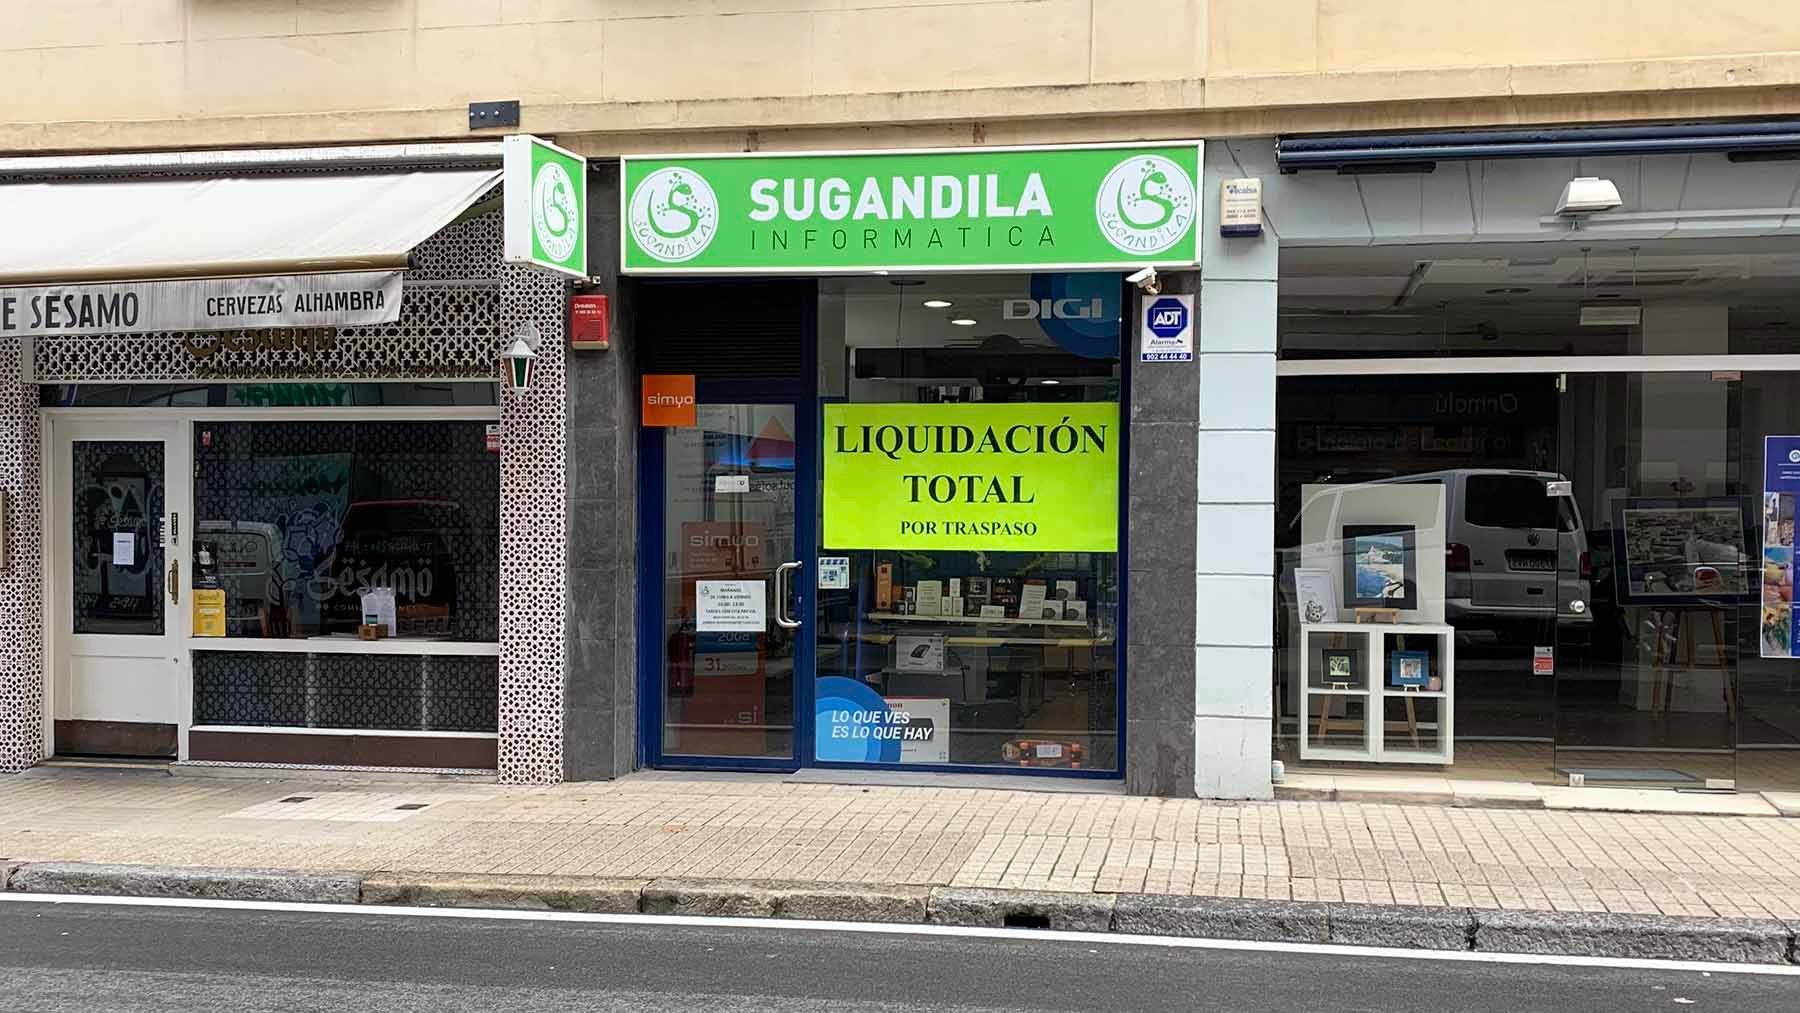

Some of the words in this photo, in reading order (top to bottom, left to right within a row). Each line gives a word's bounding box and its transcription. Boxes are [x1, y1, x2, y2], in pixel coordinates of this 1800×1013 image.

[747, 172, 1054, 222] SUGANDILA
[751, 225, 1055, 250] INFORMATICA
[30, 292, 139, 329] SESAMO
[206, 294, 283, 317] CERVEZAS
[294, 290, 385, 313] ALHAMBRA
[1003, 298, 1103, 320] DIGI
[1153, 312, 1182, 326] ADT
[647, 392, 694, 408] simyo
[834, 416, 1108, 460] LIQUIDACIÓN
[903, 475, 1035, 503] TOTAL
[900, 521, 936, 535] POR
[942, 521, 1037, 536] TRASPASO
[831, 710, 849, 723] LO
[853, 711, 881, 724] QUE
[884, 711, 910, 724] VES
[831, 726, 849, 738] ES
[852, 727, 870, 738] LO
[873, 727, 901, 740] QUE
[904, 728, 933, 740] HAY
